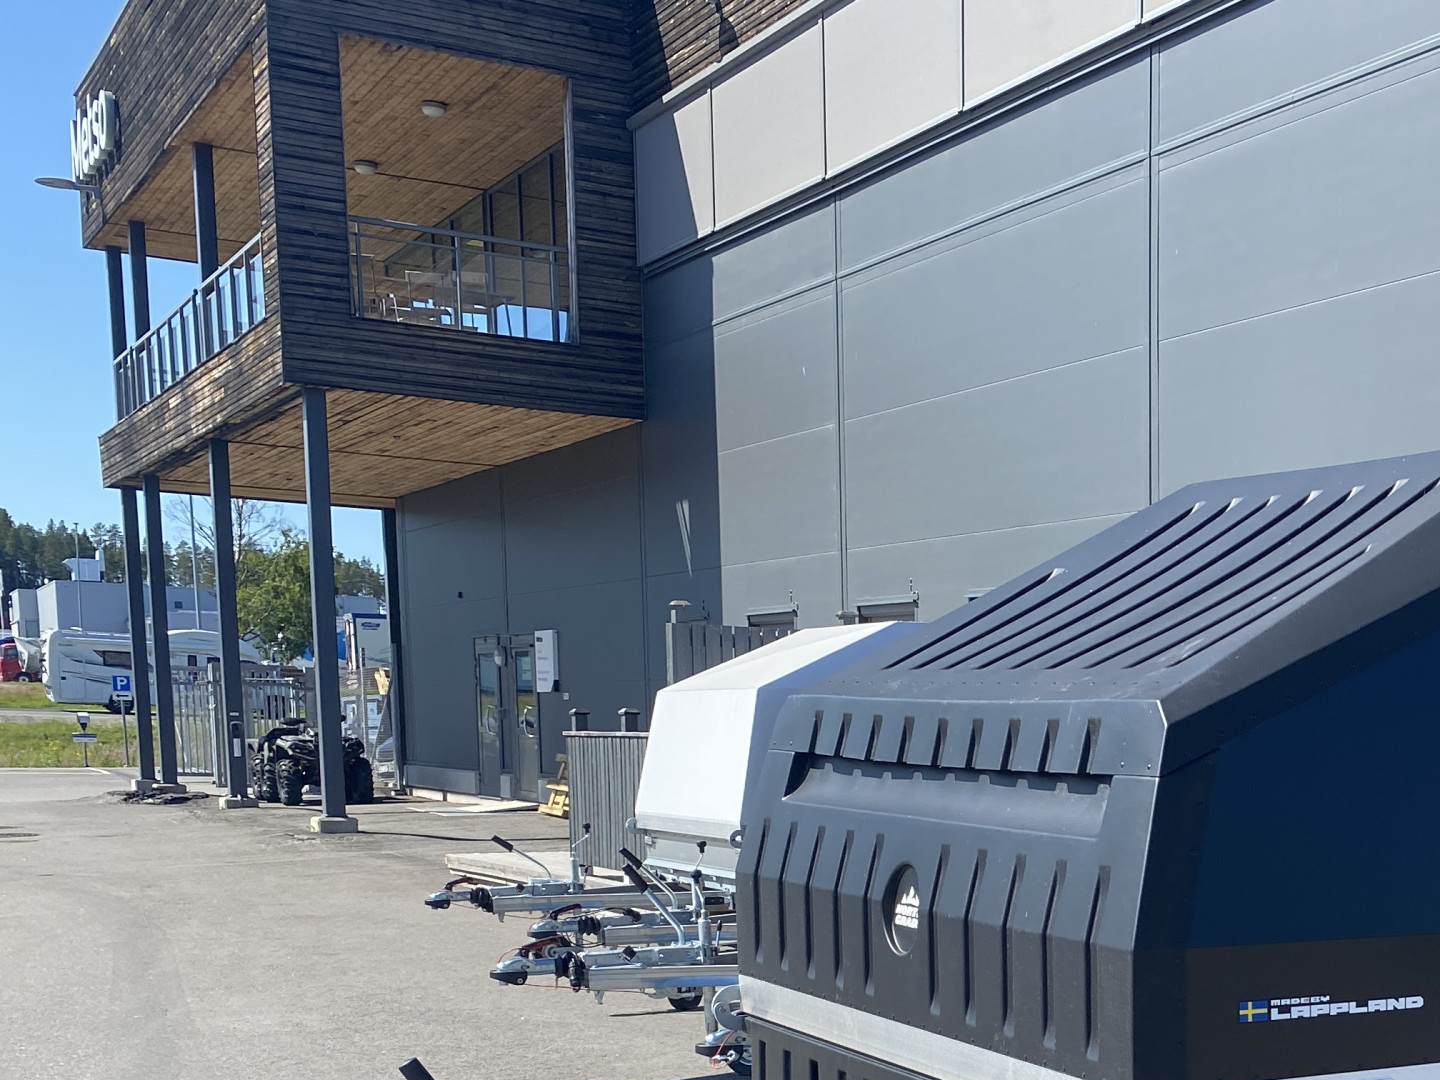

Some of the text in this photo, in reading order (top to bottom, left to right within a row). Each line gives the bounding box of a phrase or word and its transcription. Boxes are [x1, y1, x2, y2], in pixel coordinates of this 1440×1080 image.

[69, 89, 107, 183] Metso
[116, 676, 127, 690] P
[895, 914, 918, 929] GRAD
[1270, 995, 1424, 1021] LAPPLAND
